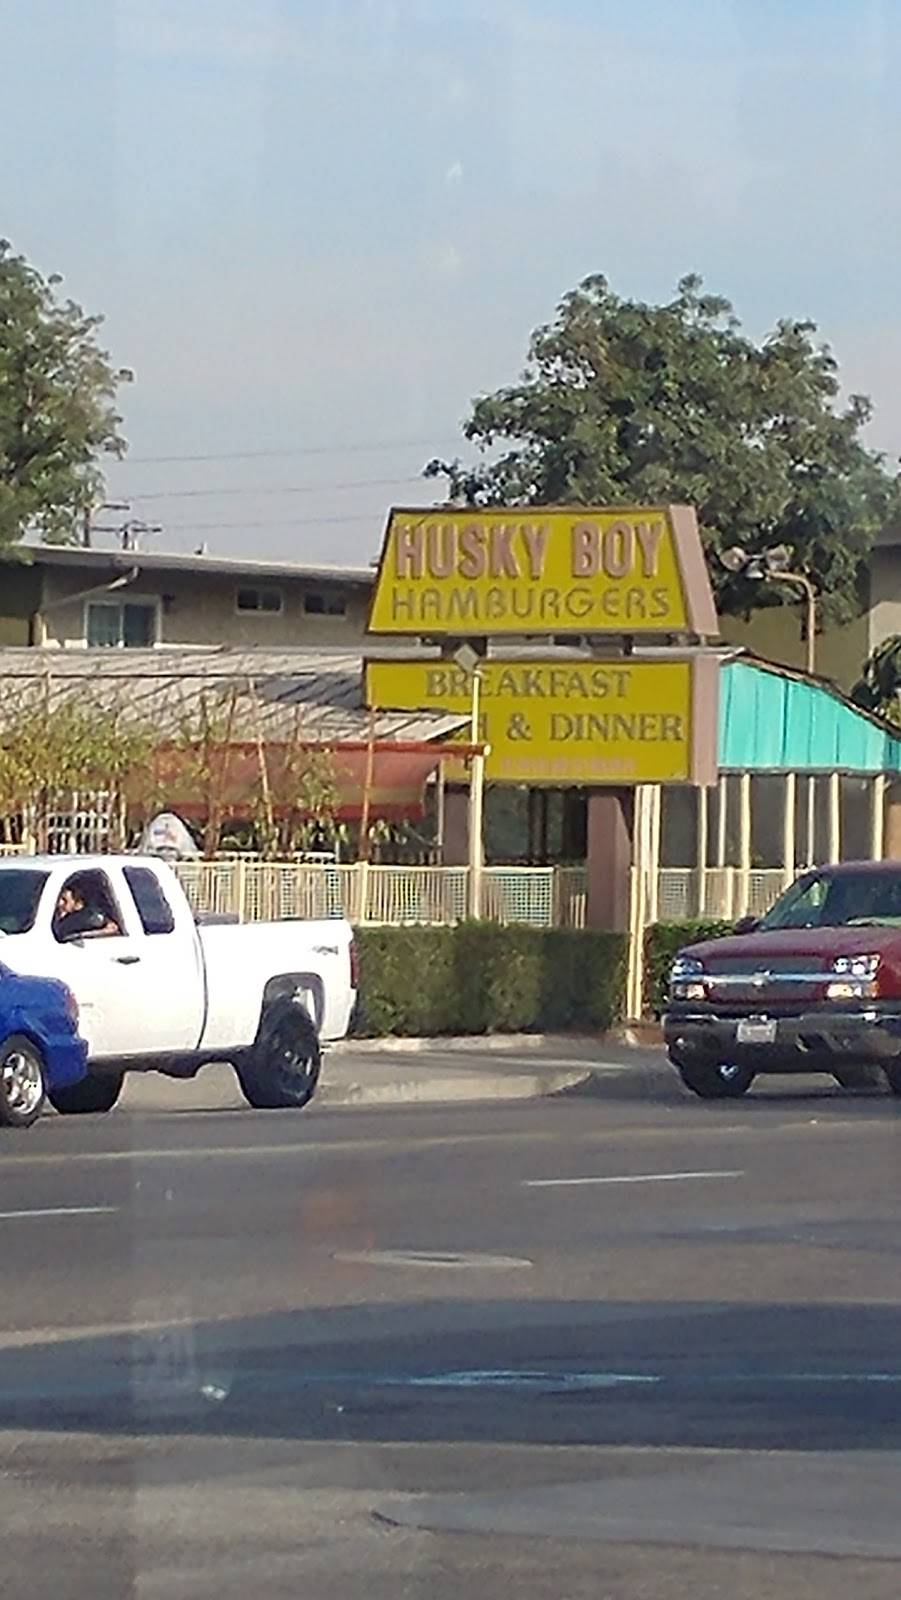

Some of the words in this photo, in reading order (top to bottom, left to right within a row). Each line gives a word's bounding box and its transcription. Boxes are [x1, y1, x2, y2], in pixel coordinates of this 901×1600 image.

[393, 522, 549, 580] HUSKY
[571, 520, 664, 579] BOY
[391, 587, 671, 620] HAMBURGERS
[426, 669, 631, 698] BREAKFAST
[506, 712, 533, 741] &
[549, 713, 684, 742] DINNER
